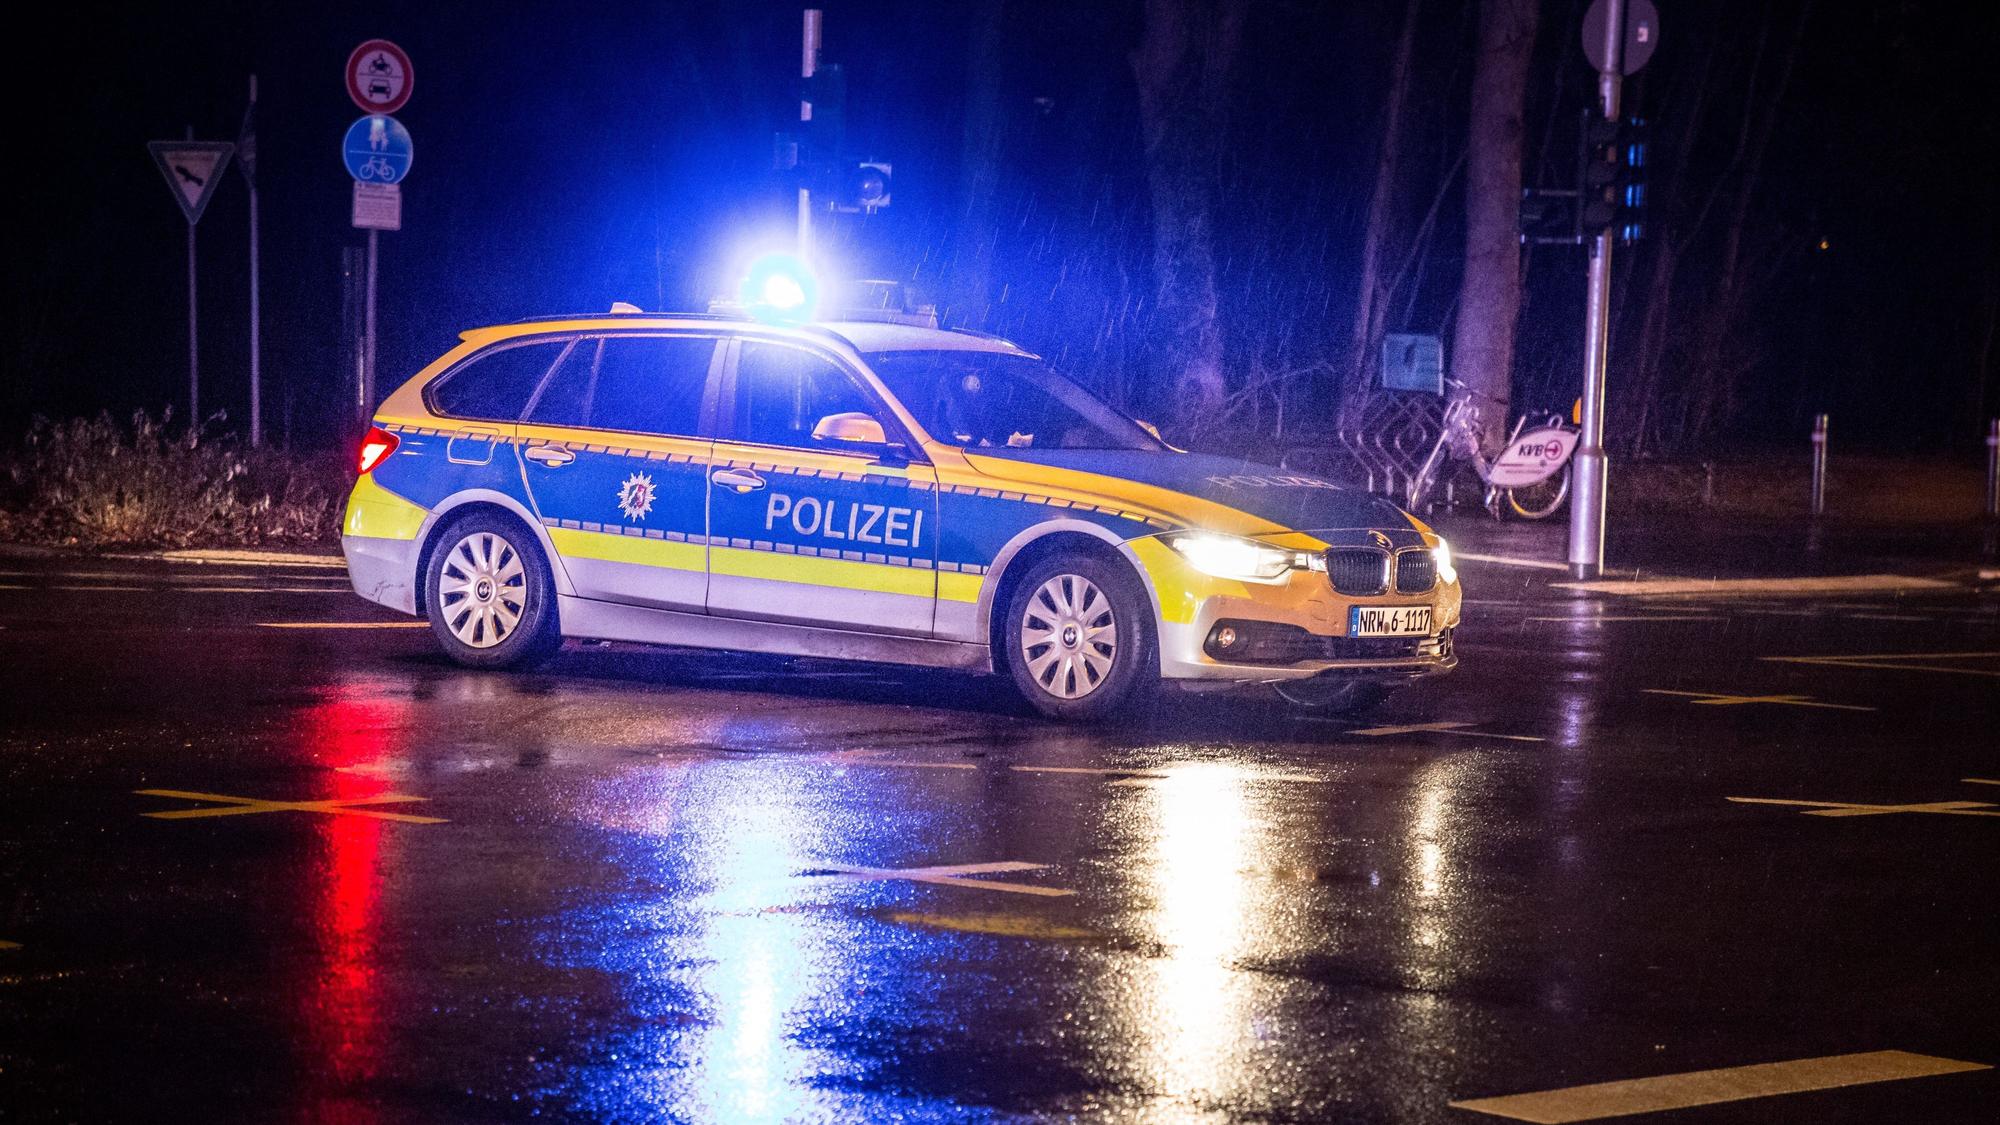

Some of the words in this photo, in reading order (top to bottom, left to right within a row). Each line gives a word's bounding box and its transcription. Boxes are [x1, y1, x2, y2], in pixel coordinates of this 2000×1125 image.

[1518, 444, 1545, 457] KVB
[765, 492, 923, 548] POLIZEI
[1359, 610, 1385, 633] NRW
[1391, 609, 1431, 633] 6-1117
